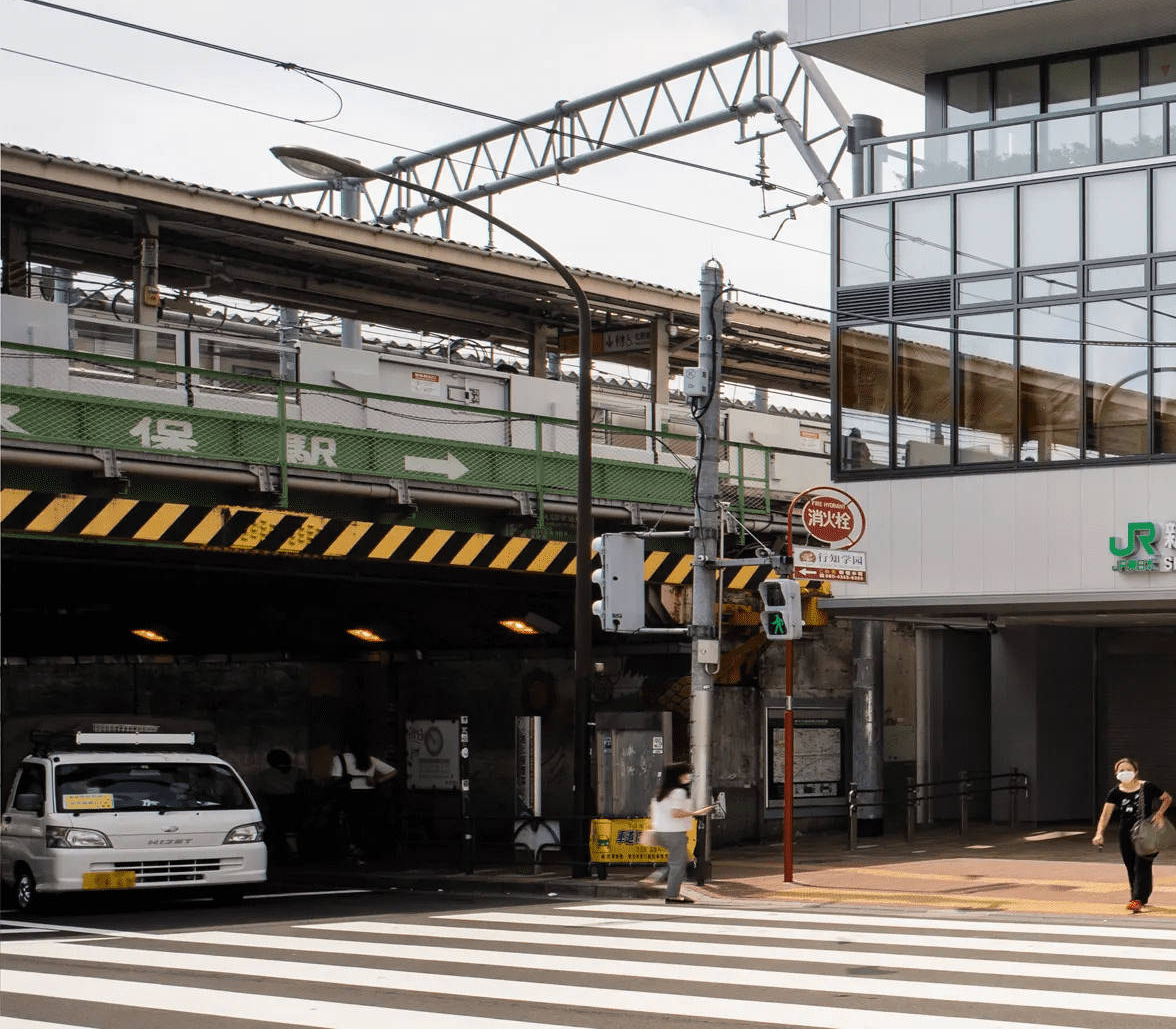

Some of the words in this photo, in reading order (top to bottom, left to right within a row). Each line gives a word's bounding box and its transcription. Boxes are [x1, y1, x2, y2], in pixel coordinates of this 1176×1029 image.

[823, 502, 846, 510] HYDRANT
[807, 508, 851, 531] 消火栓
[1109, 521, 1157, 557] JR
[148, 838, 194, 846] HIJET
